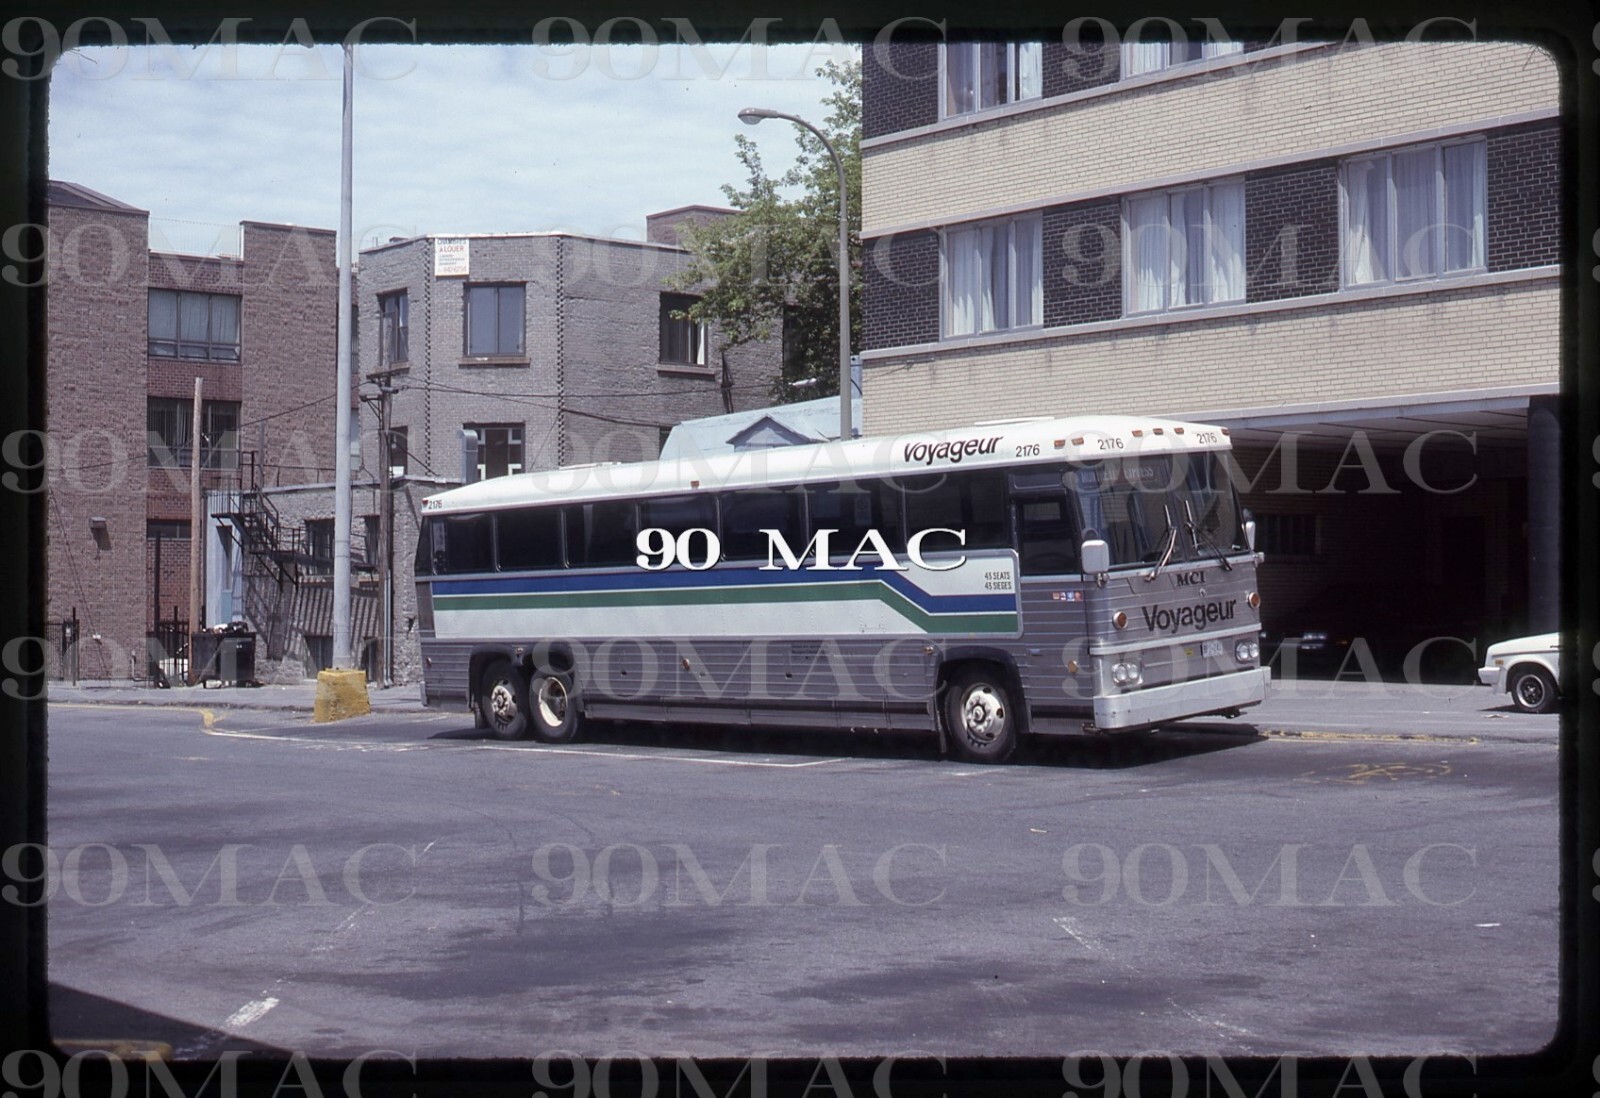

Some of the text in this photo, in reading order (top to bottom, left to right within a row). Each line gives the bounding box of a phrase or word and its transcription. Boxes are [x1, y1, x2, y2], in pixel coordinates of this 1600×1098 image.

[1098, 438, 1124, 450] 2176
[1197, 432, 1217, 444] 2176
[904, 436, 1004, 466] Voyageur
[1015, 444, 1041, 458] 2176
[428, 500, 443, 509] 2176
[993, 571, 1011, 580] SEATS
[1176, 571, 1206, 587] MCI
[1142, 599, 1237, 634] Voyageur
